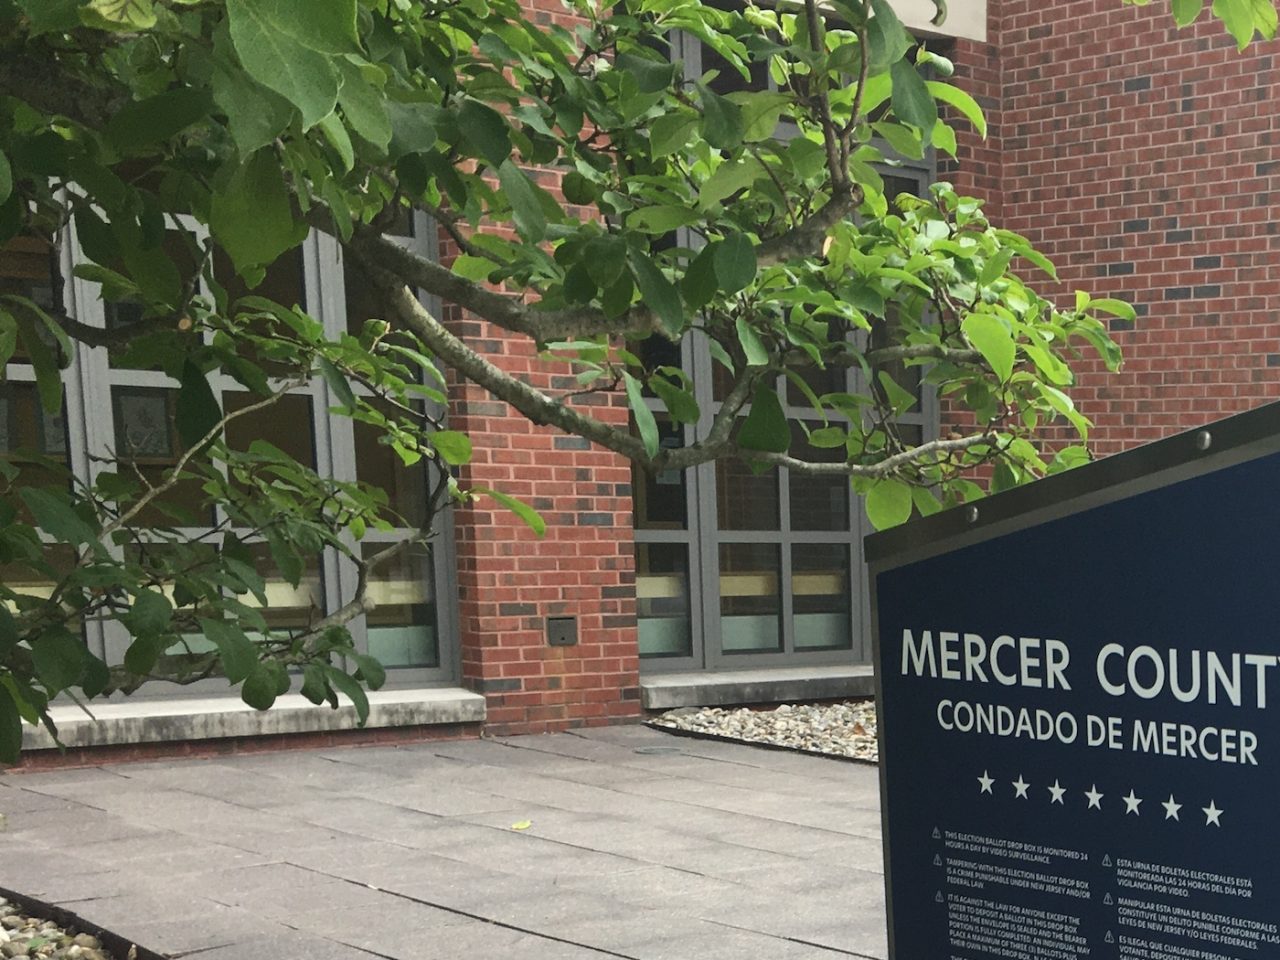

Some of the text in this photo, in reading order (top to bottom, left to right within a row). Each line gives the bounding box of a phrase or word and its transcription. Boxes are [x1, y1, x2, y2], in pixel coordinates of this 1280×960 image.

[901, 629, 1072, 691] MERCER
[937, 699, 1258, 766] CONDADO DE MERCER
[945, 831, 957, 839] THIS
[958, 833, 984, 844] ELECTION
[985, 837, 1006, 847] BALLOT
[1007, 841, 1022, 850] DROP
[1023, 843, 1036, 852] BOX
[1043, 846, 1080, 859] MONITORED
[1080, 852, 1089, 861] 24
[945, 841, 964, 850] HOURS
[989, 848, 1007, 857] VIDEO
[1117, 858, 1252, 887] ESTA URNA DE BOLETAS ELECTORALES ESTÁ
[1117, 869, 1253, 898] MONITOREADA LAS 24 HORAS DEL DÍA POR
[1117, 879, 1152, 891] VIGILANCIA
[1153, 885, 1167, 894] POR
[1118, 898, 1278, 933] MANIPULAR ESTA URNA DE BOLETAS ELECTORALES
[1118, 907, 1280, 943] CONSTITUYE UN DELITO PUNIBLE CONFORME A LAS
[1119, 917, 1136, 927] LEYES
[1137, 920, 1146, 929] DE
[1146, 922, 1162, 932] NEW
[1163, 925, 1185, 936] JERSEY
[1199, 932, 1219, 942] LEYES
